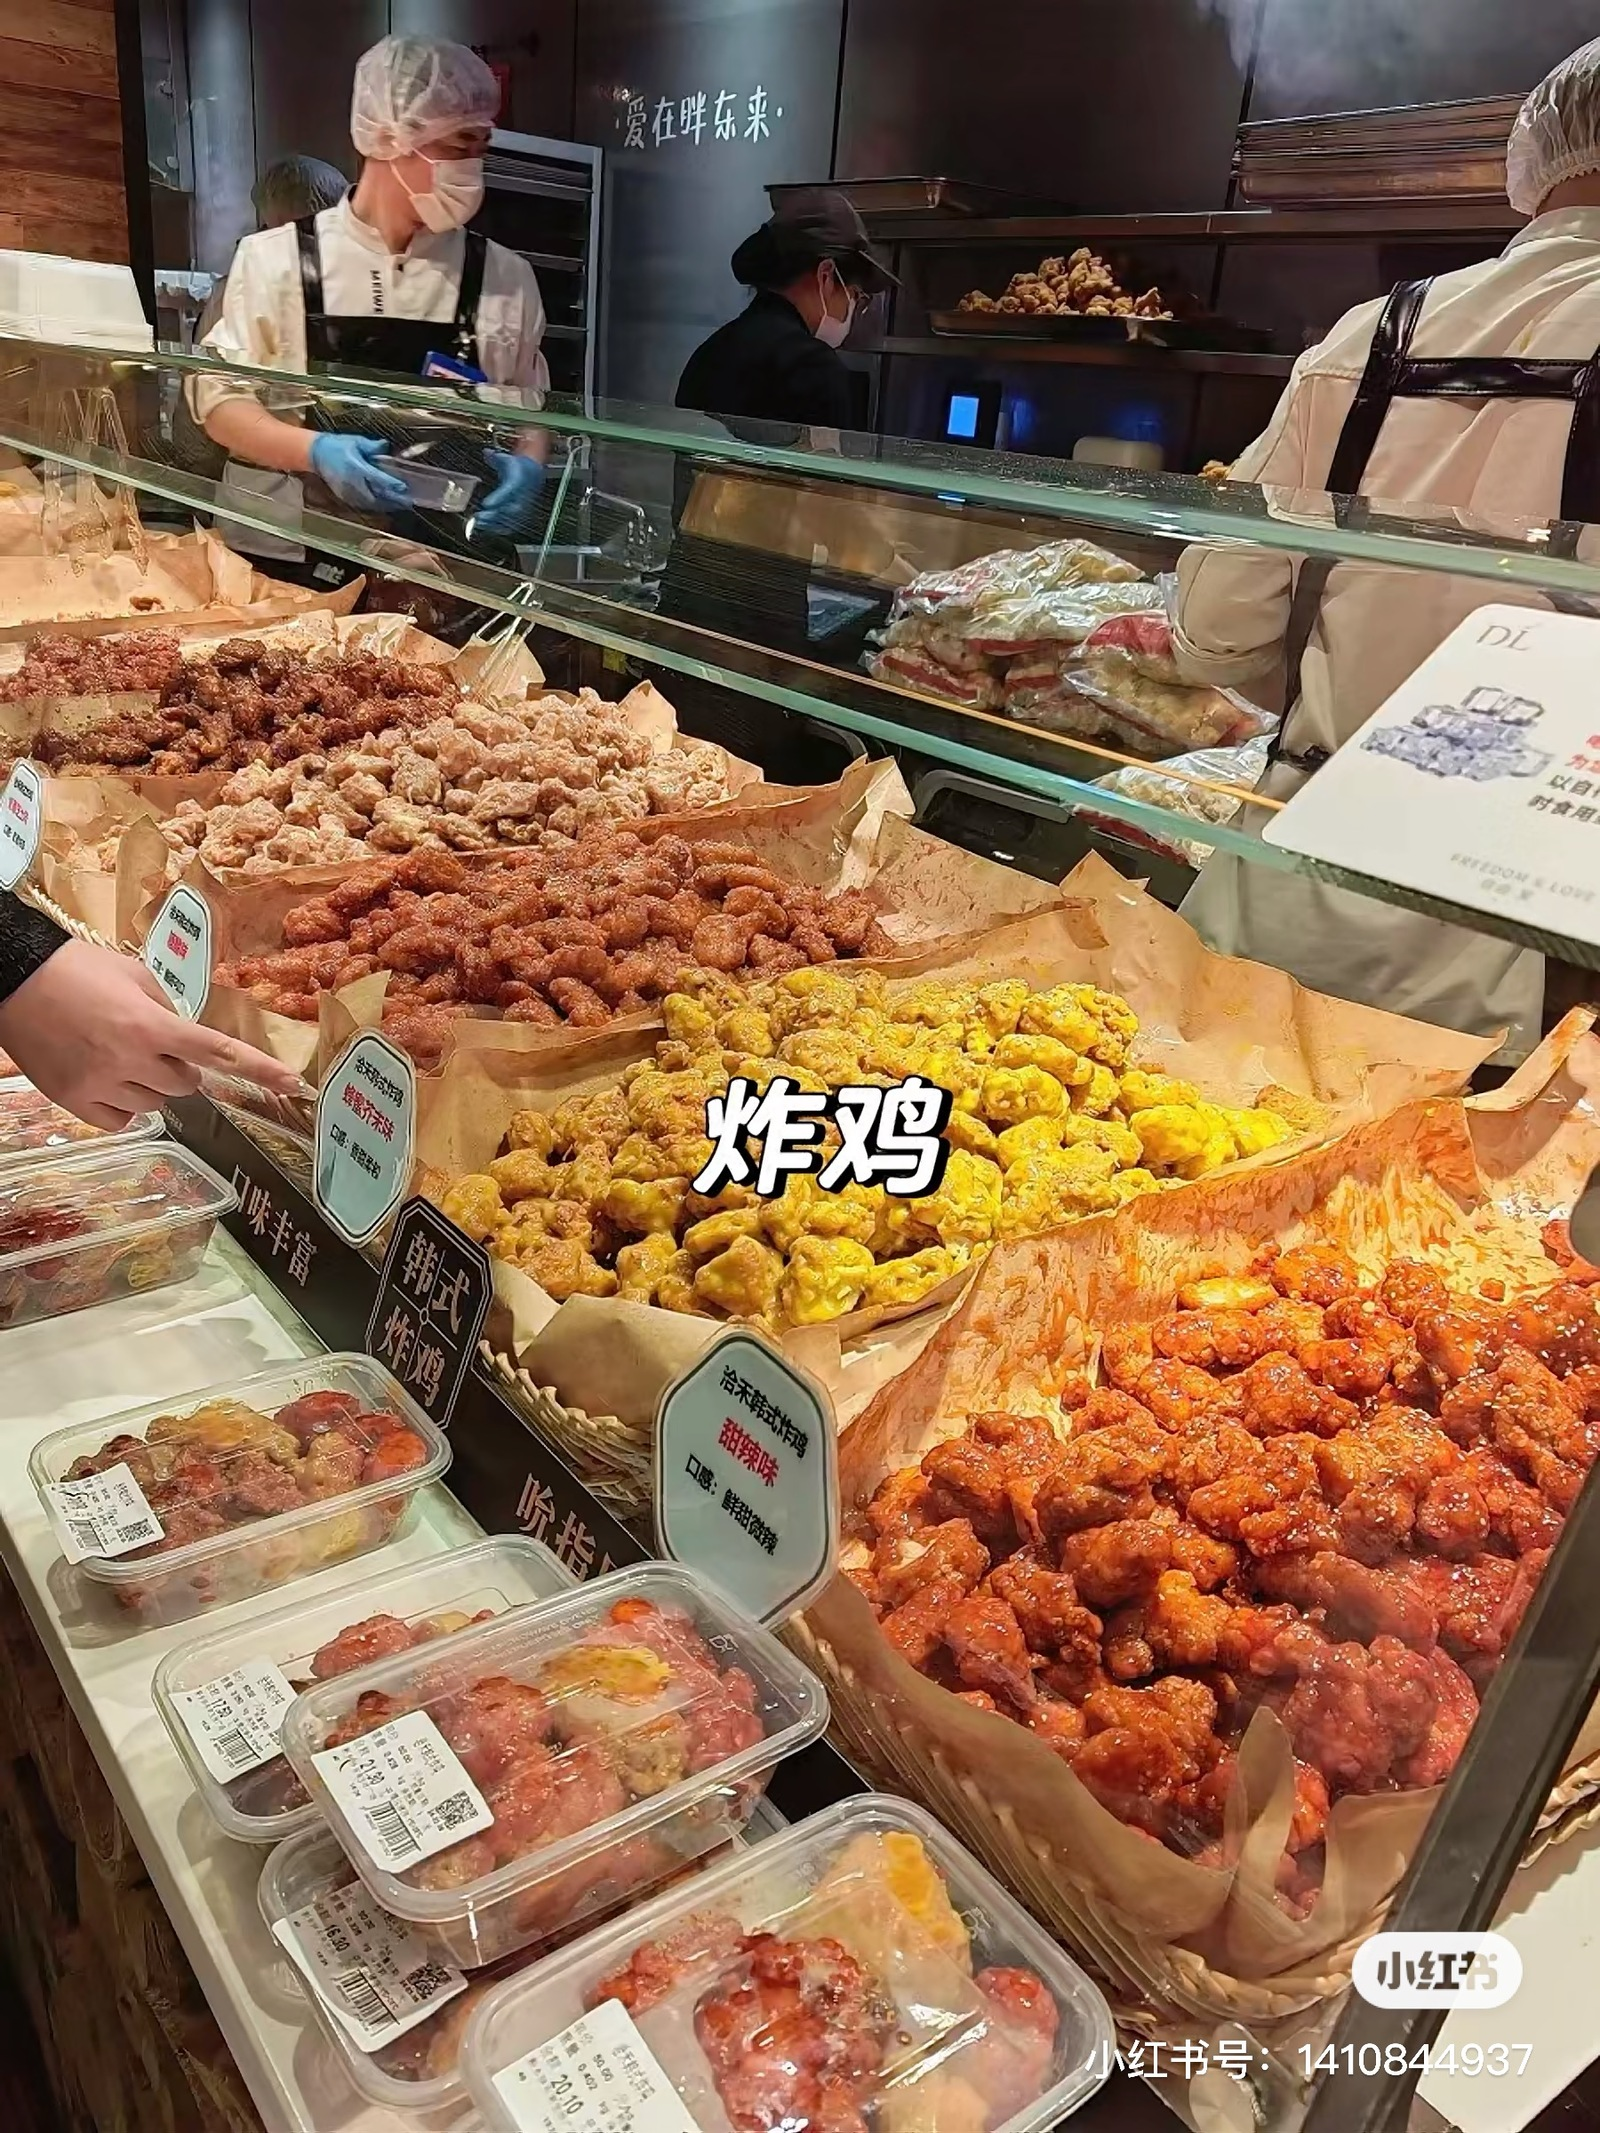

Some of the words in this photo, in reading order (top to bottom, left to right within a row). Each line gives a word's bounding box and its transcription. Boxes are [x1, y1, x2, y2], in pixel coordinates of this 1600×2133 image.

[231, 1164, 318, 1287] 口味丰富
[402, 1230, 471, 1335] 韩式
[377, 1304, 446, 1407] 炸鸡
[718, 1417, 779, 1487] 甜辣味
[720, 1365, 809, 1459] 洽禾韩式炸鸡
[516, 1472, 618, 1584] 吮指
[550, 2074, 584, 2115] 20.10
